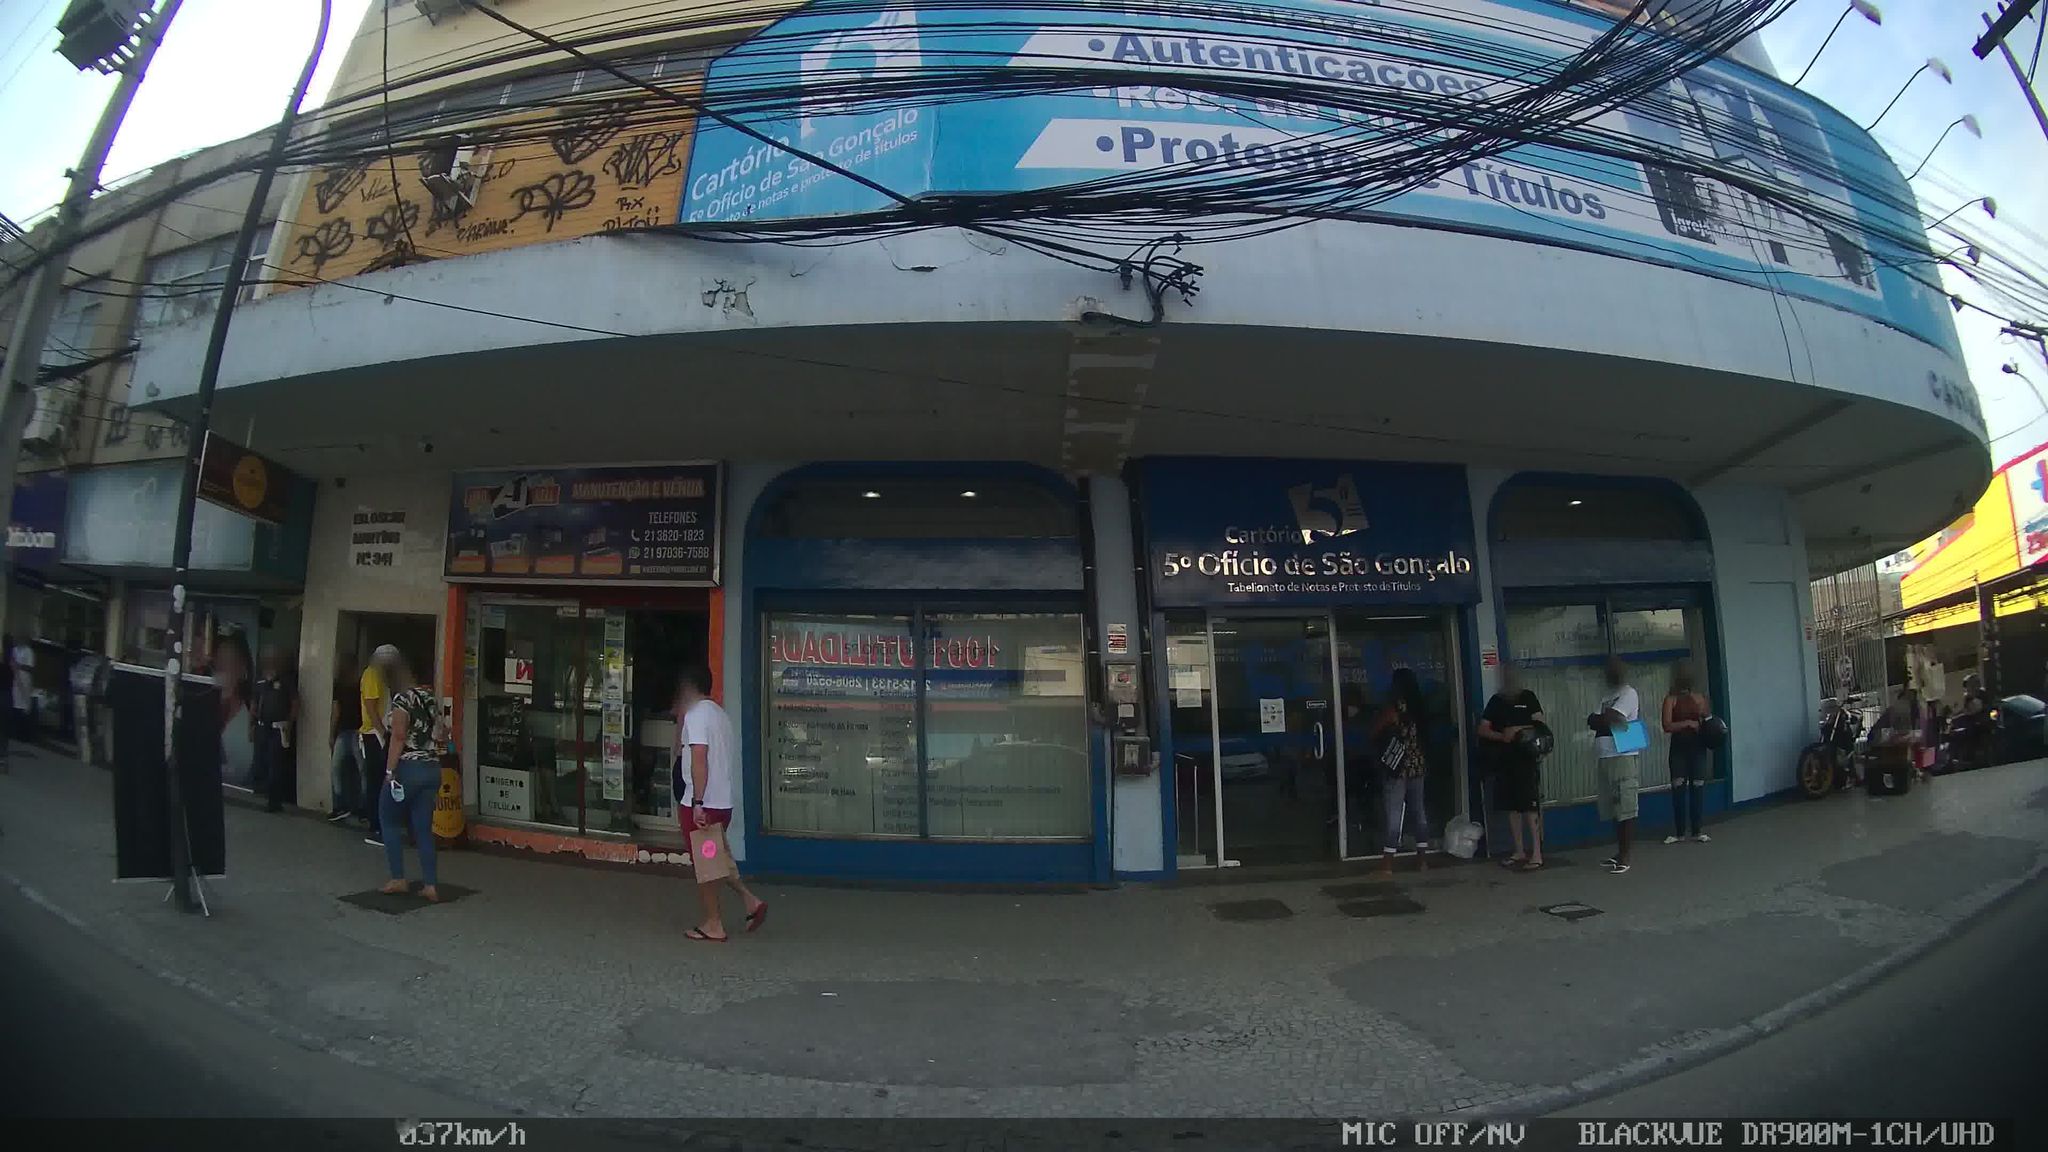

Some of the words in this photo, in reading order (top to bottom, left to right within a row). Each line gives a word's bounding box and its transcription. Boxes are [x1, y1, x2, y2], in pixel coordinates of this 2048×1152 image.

[759, 168, 783, 190] de
[648, 511, 698, 524] TELEFONES
[1225, 525, 1300, 544] Cartório
[1164, 552, 1192, 577] 5º
[1198, 550, 1277, 577] Ofício
[1285, 554, 1316, 576] de
[1322, 551, 1369, 576] São
[1374, 551, 1471, 582] Gonçalo
[1227, 582, 1286, 593] Tabelionato
[1287, 581, 1300, 592] de
[1301, 582, 1330, 592] Notas
[1332, 584, 1338, 592] e
